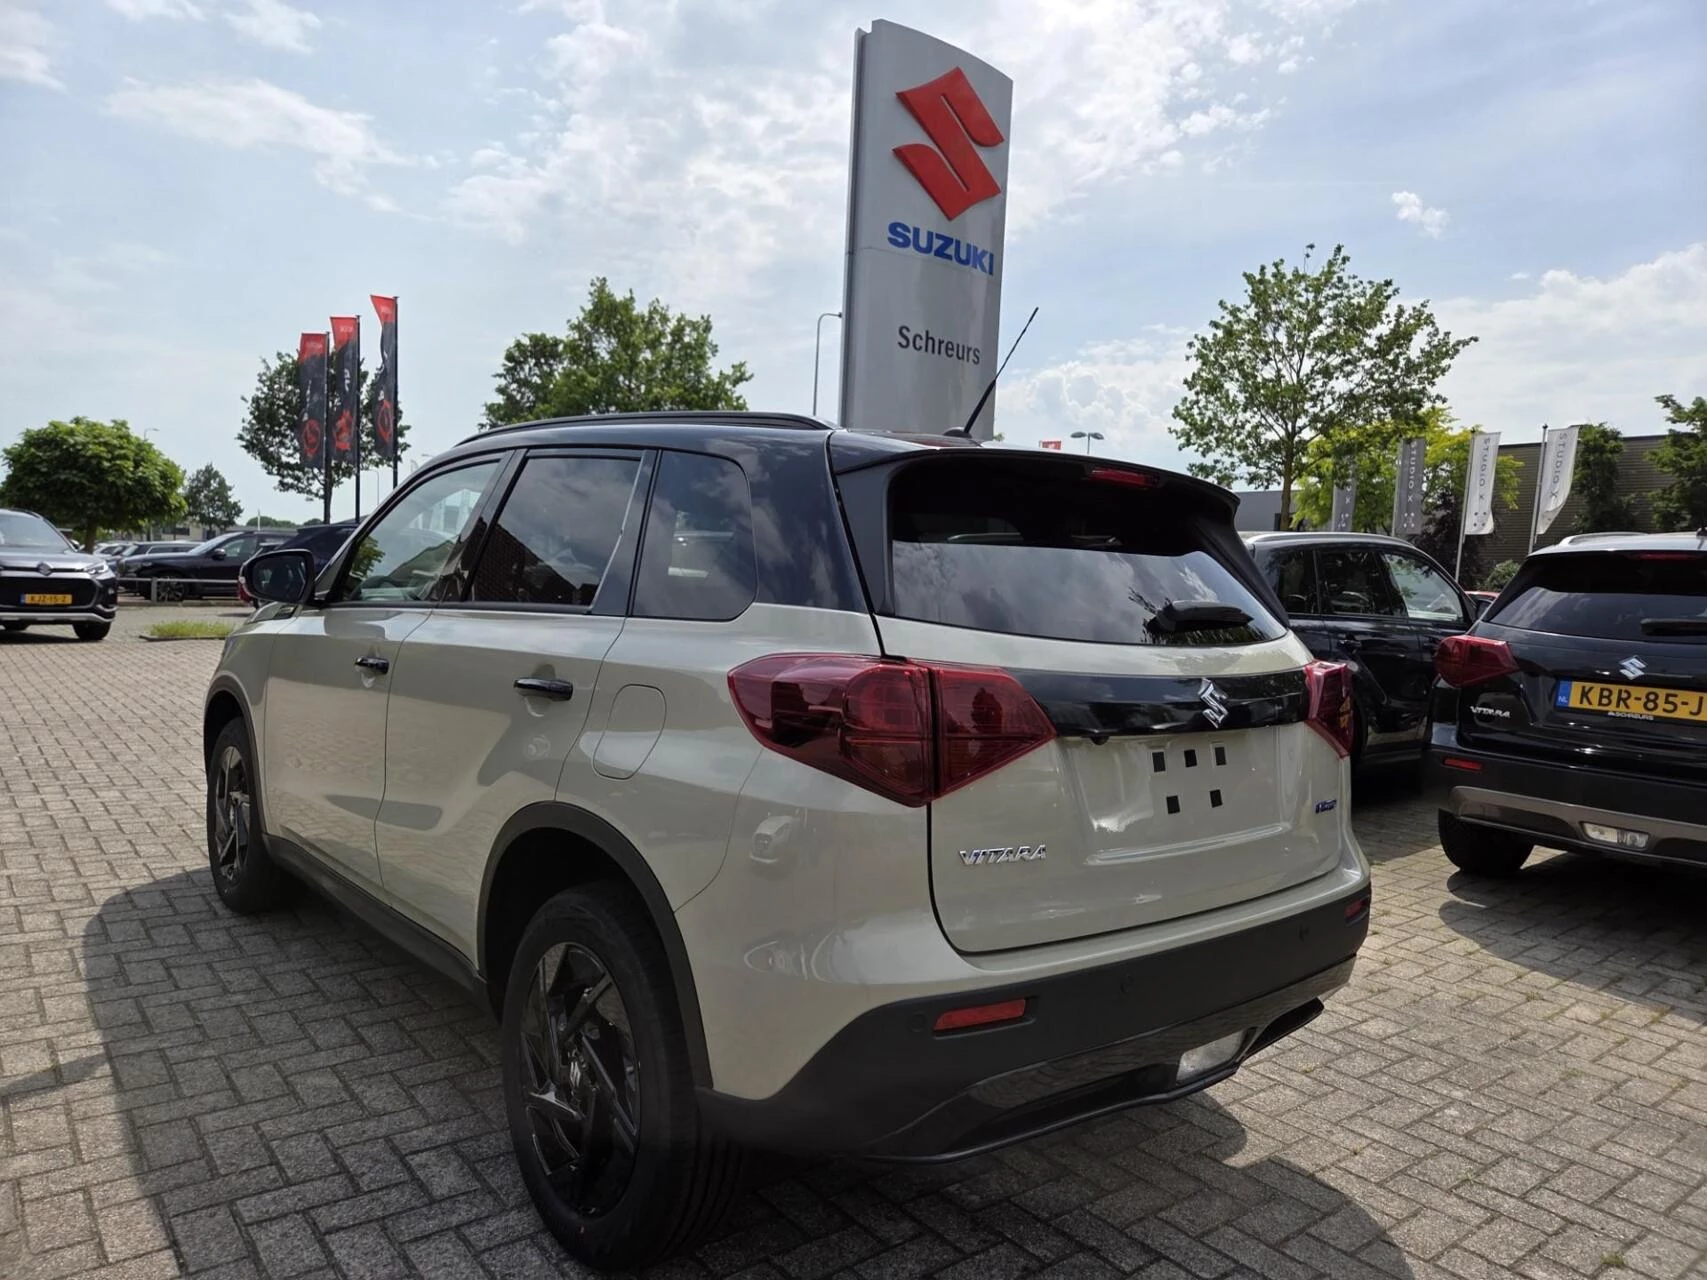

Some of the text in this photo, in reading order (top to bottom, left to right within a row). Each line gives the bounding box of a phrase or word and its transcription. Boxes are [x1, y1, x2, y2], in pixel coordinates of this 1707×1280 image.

[887, 222, 994, 276] SUZUKI
[898, 325, 981, 366] Schreurs
[1408, 441, 1418, 489] STUDIO
[1479, 437, 1491, 487] STUDIO
[1551, 432, 1568, 485] STUDIO
[1470, 705, 1511, 718] VITARA
[1558, 695, 1568, 704] NL
[1579, 685, 1704, 716] KBR-85-J
[958, 843, 1047, 867] VITARA
